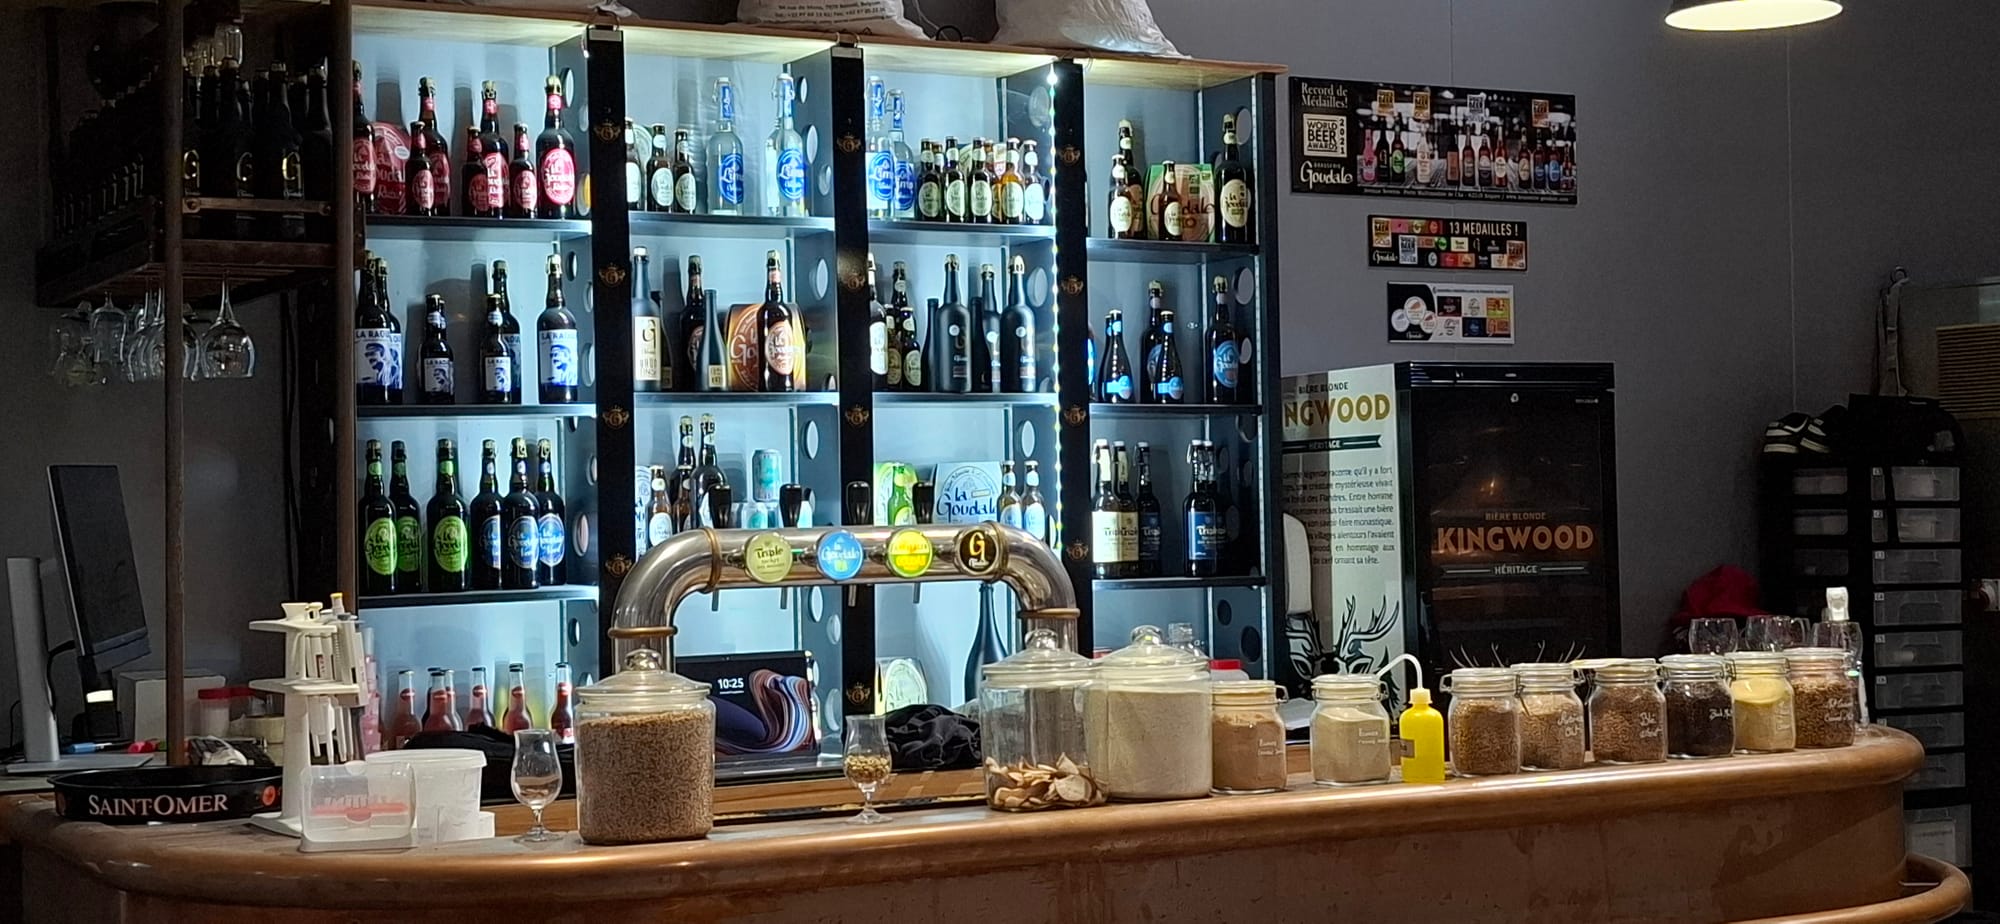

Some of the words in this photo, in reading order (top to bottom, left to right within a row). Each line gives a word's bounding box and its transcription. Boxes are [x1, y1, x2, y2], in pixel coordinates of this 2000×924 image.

[1302, 82, 1335, 96] Record
[1336, 84, 1349, 97] de
[1302, 95, 1349, 109] Médailles!
[1307, 120, 1338, 130] WORLD
[1307, 129, 1337, 143] BEER
[1307, 143, 1338, 152] AWARDS
[1300, 160, 1353, 190] Goudale
[1449, 221, 1460, 234] 13
[1462, 221, 1512, 236] MEDAILLES
[1514, 224, 1519, 237] !
[1298, 383, 1319, 394] BIÈRE
[1320, 382, 1349, 393] BLONDE
[955, 487, 967, 501] la
[937, 492, 997, 523] Goudal
[1485, 511, 1512, 521] BIÈRE
[1512, 511, 1547, 521] BLONDE
[1437, 524, 1594, 553] KINGWOOD
[754, 545, 784, 559] Triple
[969, 531, 986, 561] G
[1494, 563, 1538, 575] HÉRITAGE
[718, 677, 745, 691] 10:25
